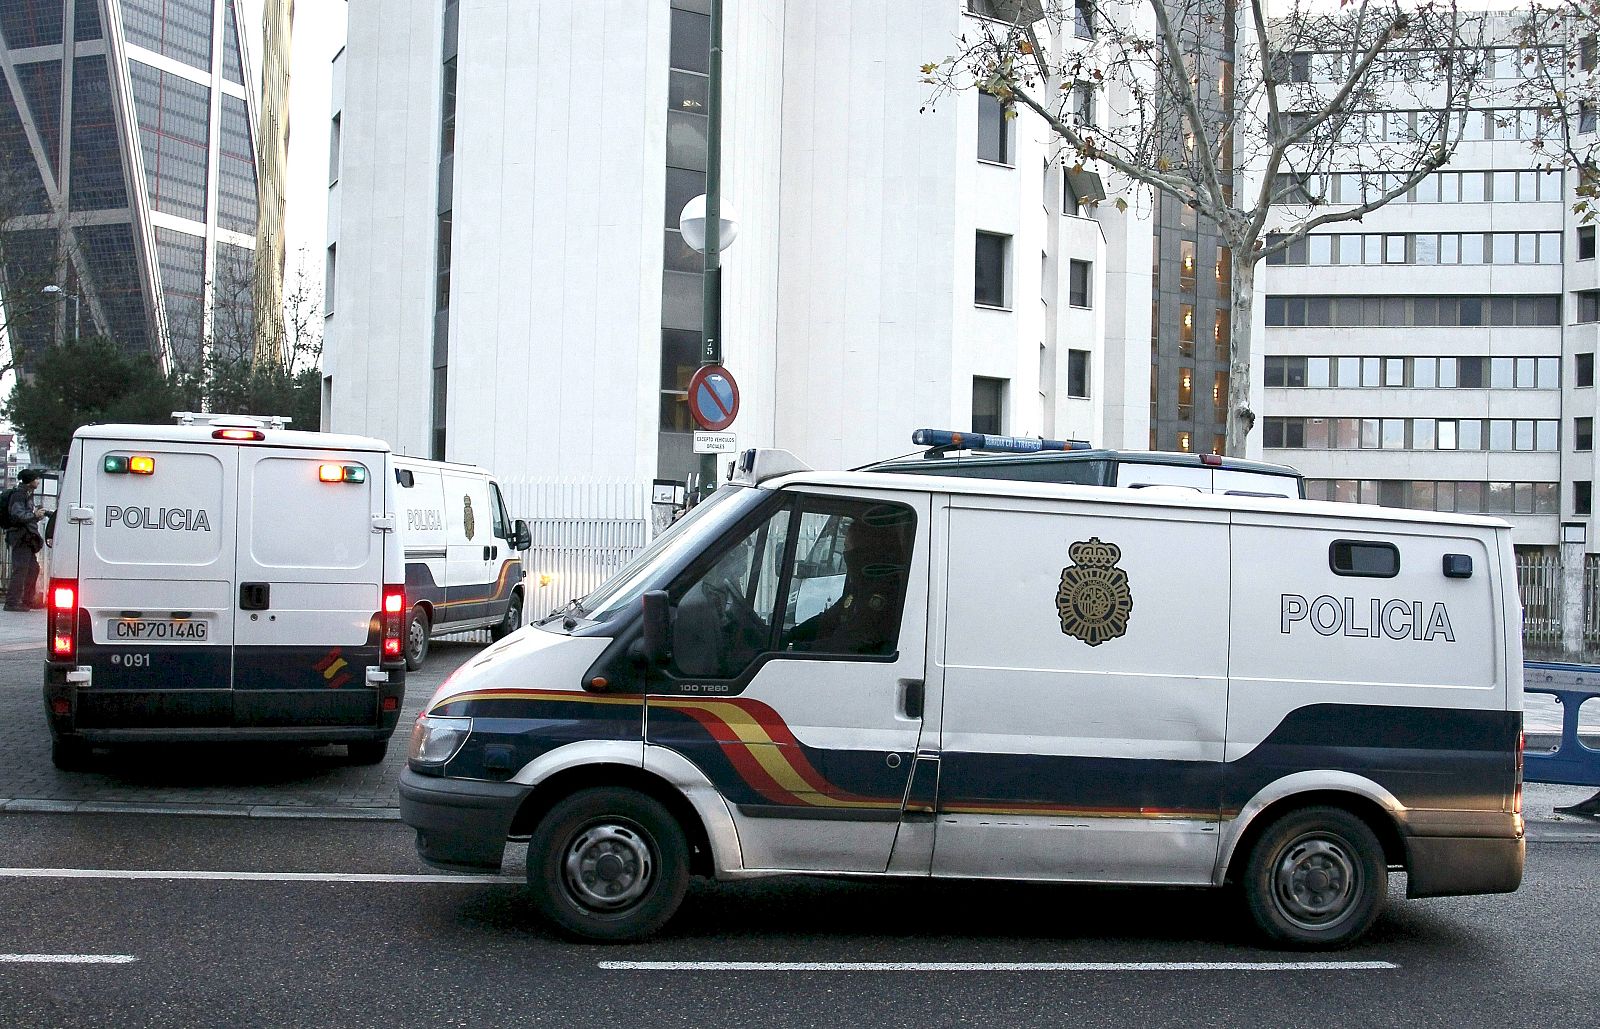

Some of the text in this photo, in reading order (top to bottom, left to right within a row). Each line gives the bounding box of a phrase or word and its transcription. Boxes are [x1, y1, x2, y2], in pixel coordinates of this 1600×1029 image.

[1005, 439, 1017, 448] CIVL
[105, 505, 211, 532] POLICIA
[407, 509, 443, 531] POLICIA
[1280, 593, 1456, 643] POLICIA
[117, 621, 206, 639] CNP7014AG
[124, 653, 150, 667] 091
